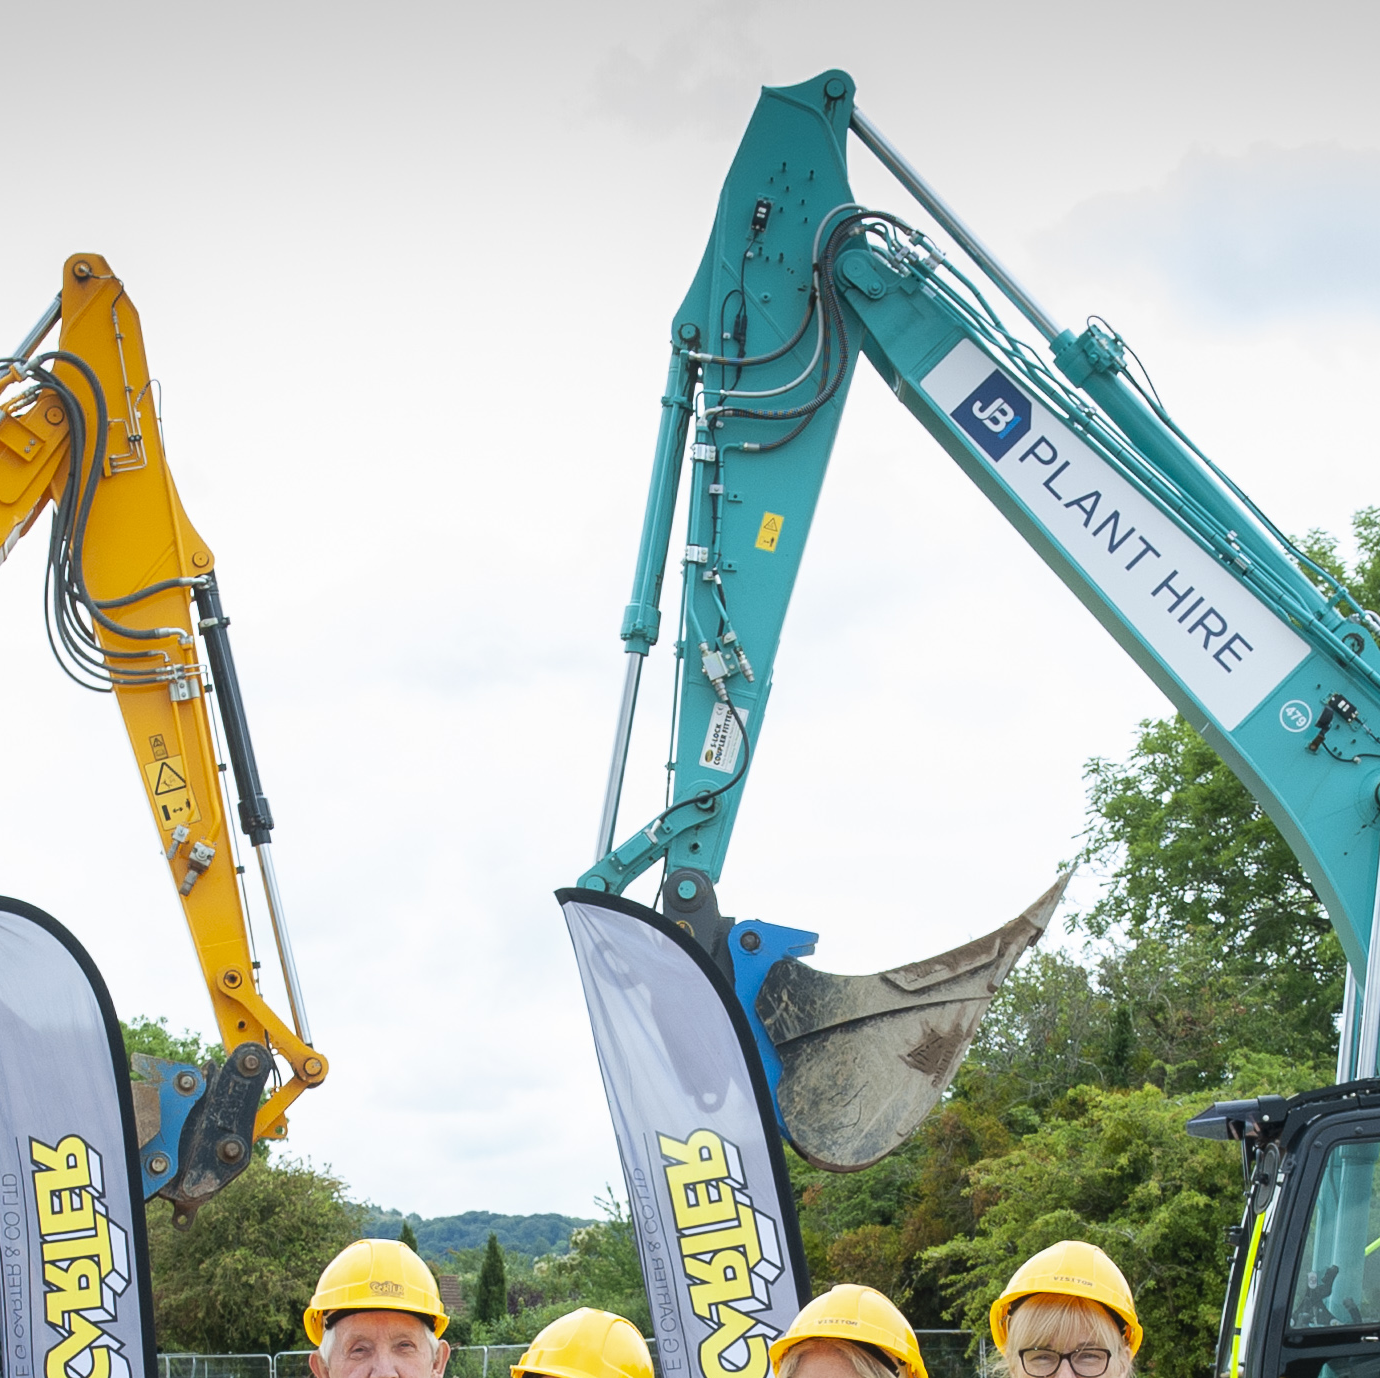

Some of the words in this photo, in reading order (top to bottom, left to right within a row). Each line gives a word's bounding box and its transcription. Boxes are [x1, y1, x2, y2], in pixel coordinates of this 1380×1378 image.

[972, 397, 1021, 439] JB1
[1018, 435, 1161, 571] PLANT
[1150, 569, 1254, 674] HIRE
[1285, 706, 1307, 727] 479
[713, 735, 727, 765] COUPLER
